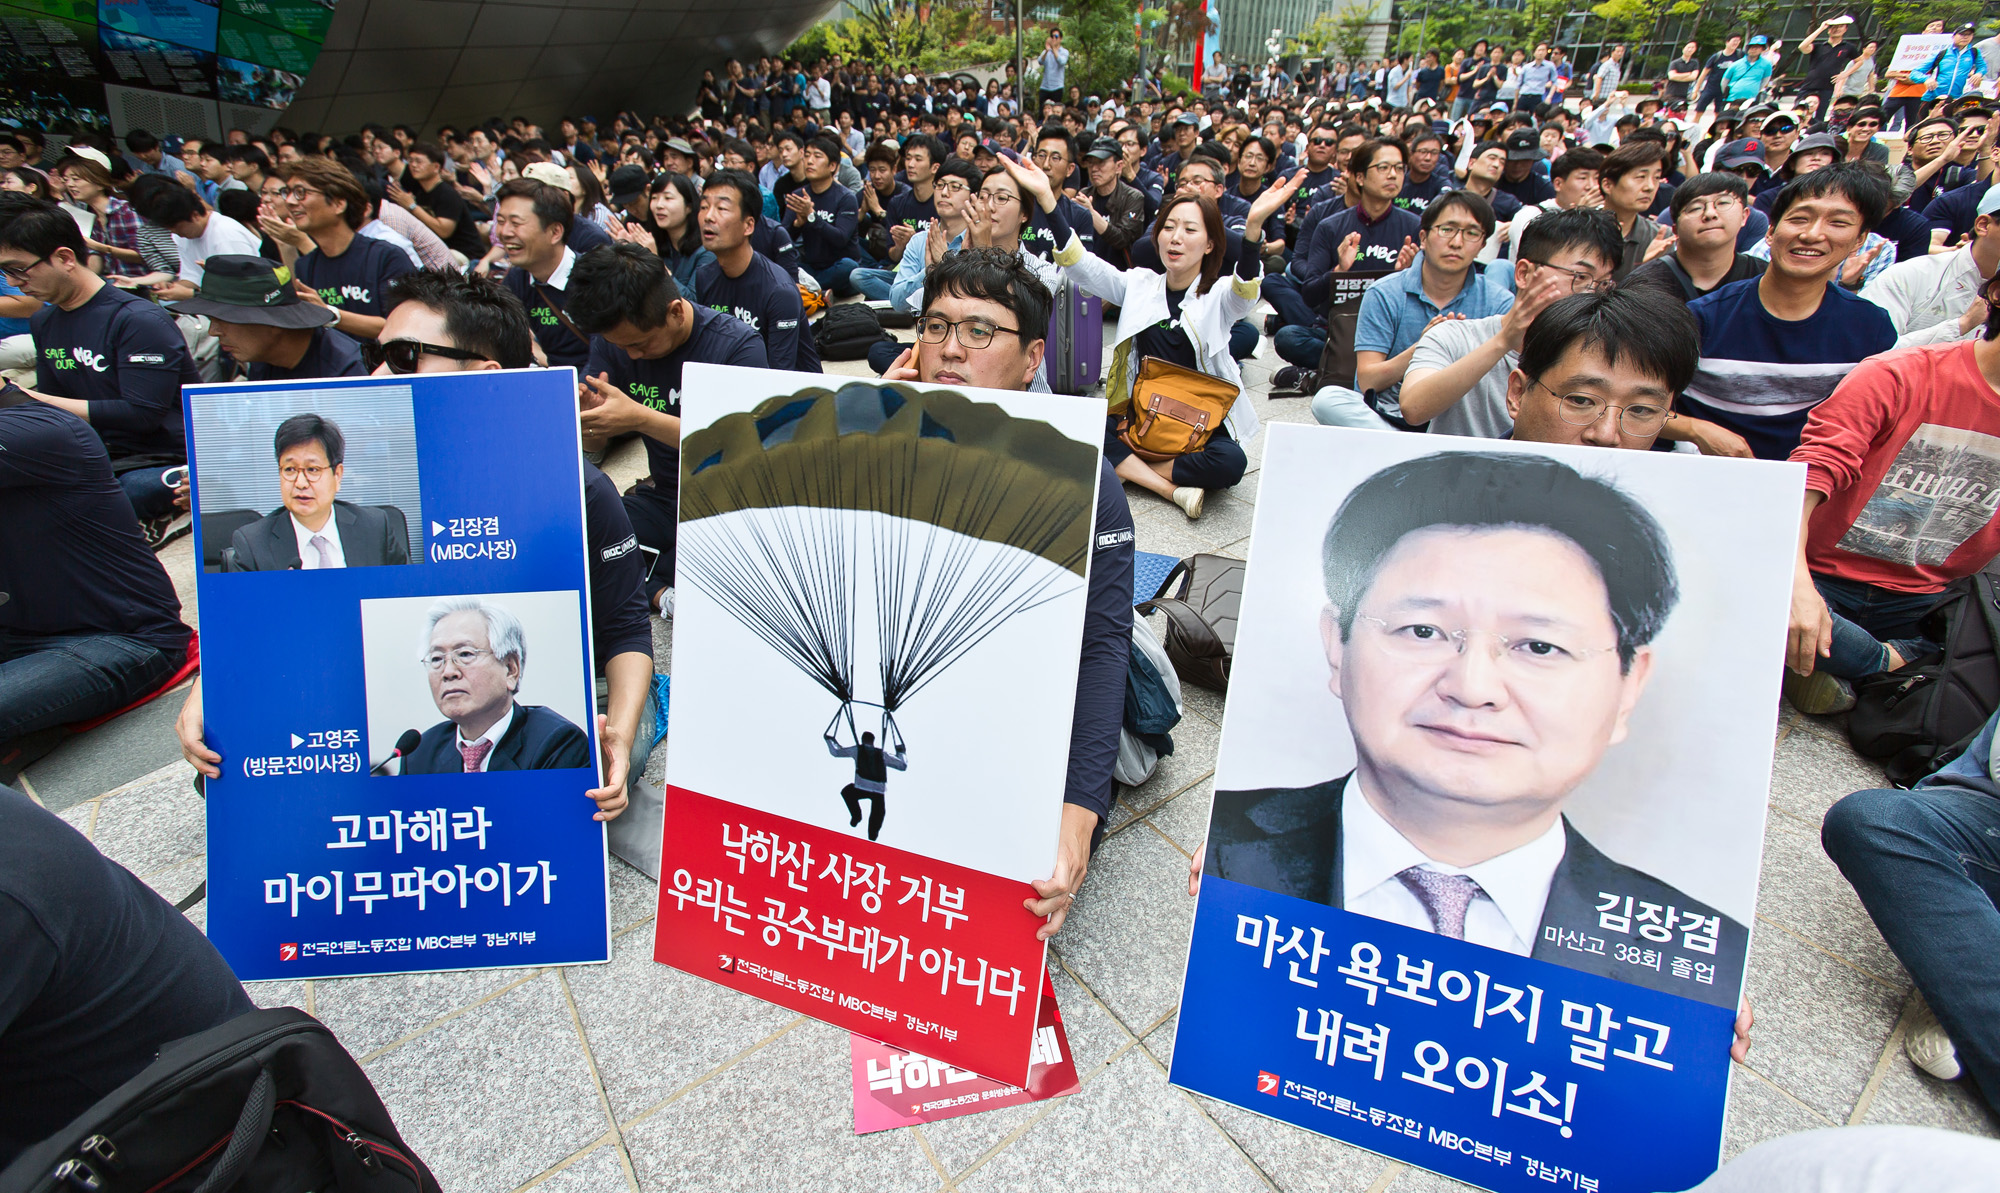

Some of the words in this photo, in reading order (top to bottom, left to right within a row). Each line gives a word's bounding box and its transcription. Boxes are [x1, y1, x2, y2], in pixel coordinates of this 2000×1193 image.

[1037, 228, 1055, 241] MB
[1366, 245, 1398, 263] MBC
[318, 287, 337, 298] SAVE
[328, 295, 344, 305] OUR
[341, 285, 371, 303] MBC
[530, 307, 551, 317] SAVE
[541, 316, 559, 326] OUR
[734, 306, 761, 330] MBC
[45, 348, 66, 359] SAVE
[55, 359, 77, 370] OUR
[73, 346, 110, 372] MBC
[629, 382, 659, 398] SAVE
[643, 397, 667, 411] OUR
[449, 517, 498, 537] 김장겸
[431, 539, 516, 562] (MBC사장)
[308, 730, 359, 748] 고영주
[244, 752, 360, 777] (방문진이사장)
[327, 807, 491, 853] 고마해라
[723, 823, 815, 892] 낙하산
[819, 853, 890, 913] 사장
[898, 876, 968, 930] 거부
[264, 861, 556, 917] 마이무따아이가
[1596, 892, 1720, 954] 김장겸
[303, 938, 411, 956] 전국언론노동조합
[417, 935, 476, 949] MBC본부
[483, 932, 535, 946] 경남지부
[668, 869, 750, 935] 우리는
[758, 897, 913, 982] 공수부대가
[920, 948, 1025, 1015] 아니다
[1545, 926, 1605, 955] 마산고
[1614, 944, 1661, 971] 38회
[1671, 957, 1715, 984] 졸업
[737, 959, 835, 1002] 전국언론노동조합
[839, 993, 897, 1022] MBC본부
[904, 1014, 957, 1042] 경남지부
[1236, 915, 1330, 988] 마산
[1338, 943, 1543, 1043] 욕보이지
[1562, 1000, 1673, 1071] 말고
[1297, 1008, 1390, 1080] 내려
[1402, 1041, 1577, 1138] 오이소!
[1284, 1081, 1422, 1138] 전국언론노동조합
[1429, 1127, 1511, 1165] MBC본부
[1521, 1154, 1599, 1193] 경남지부
